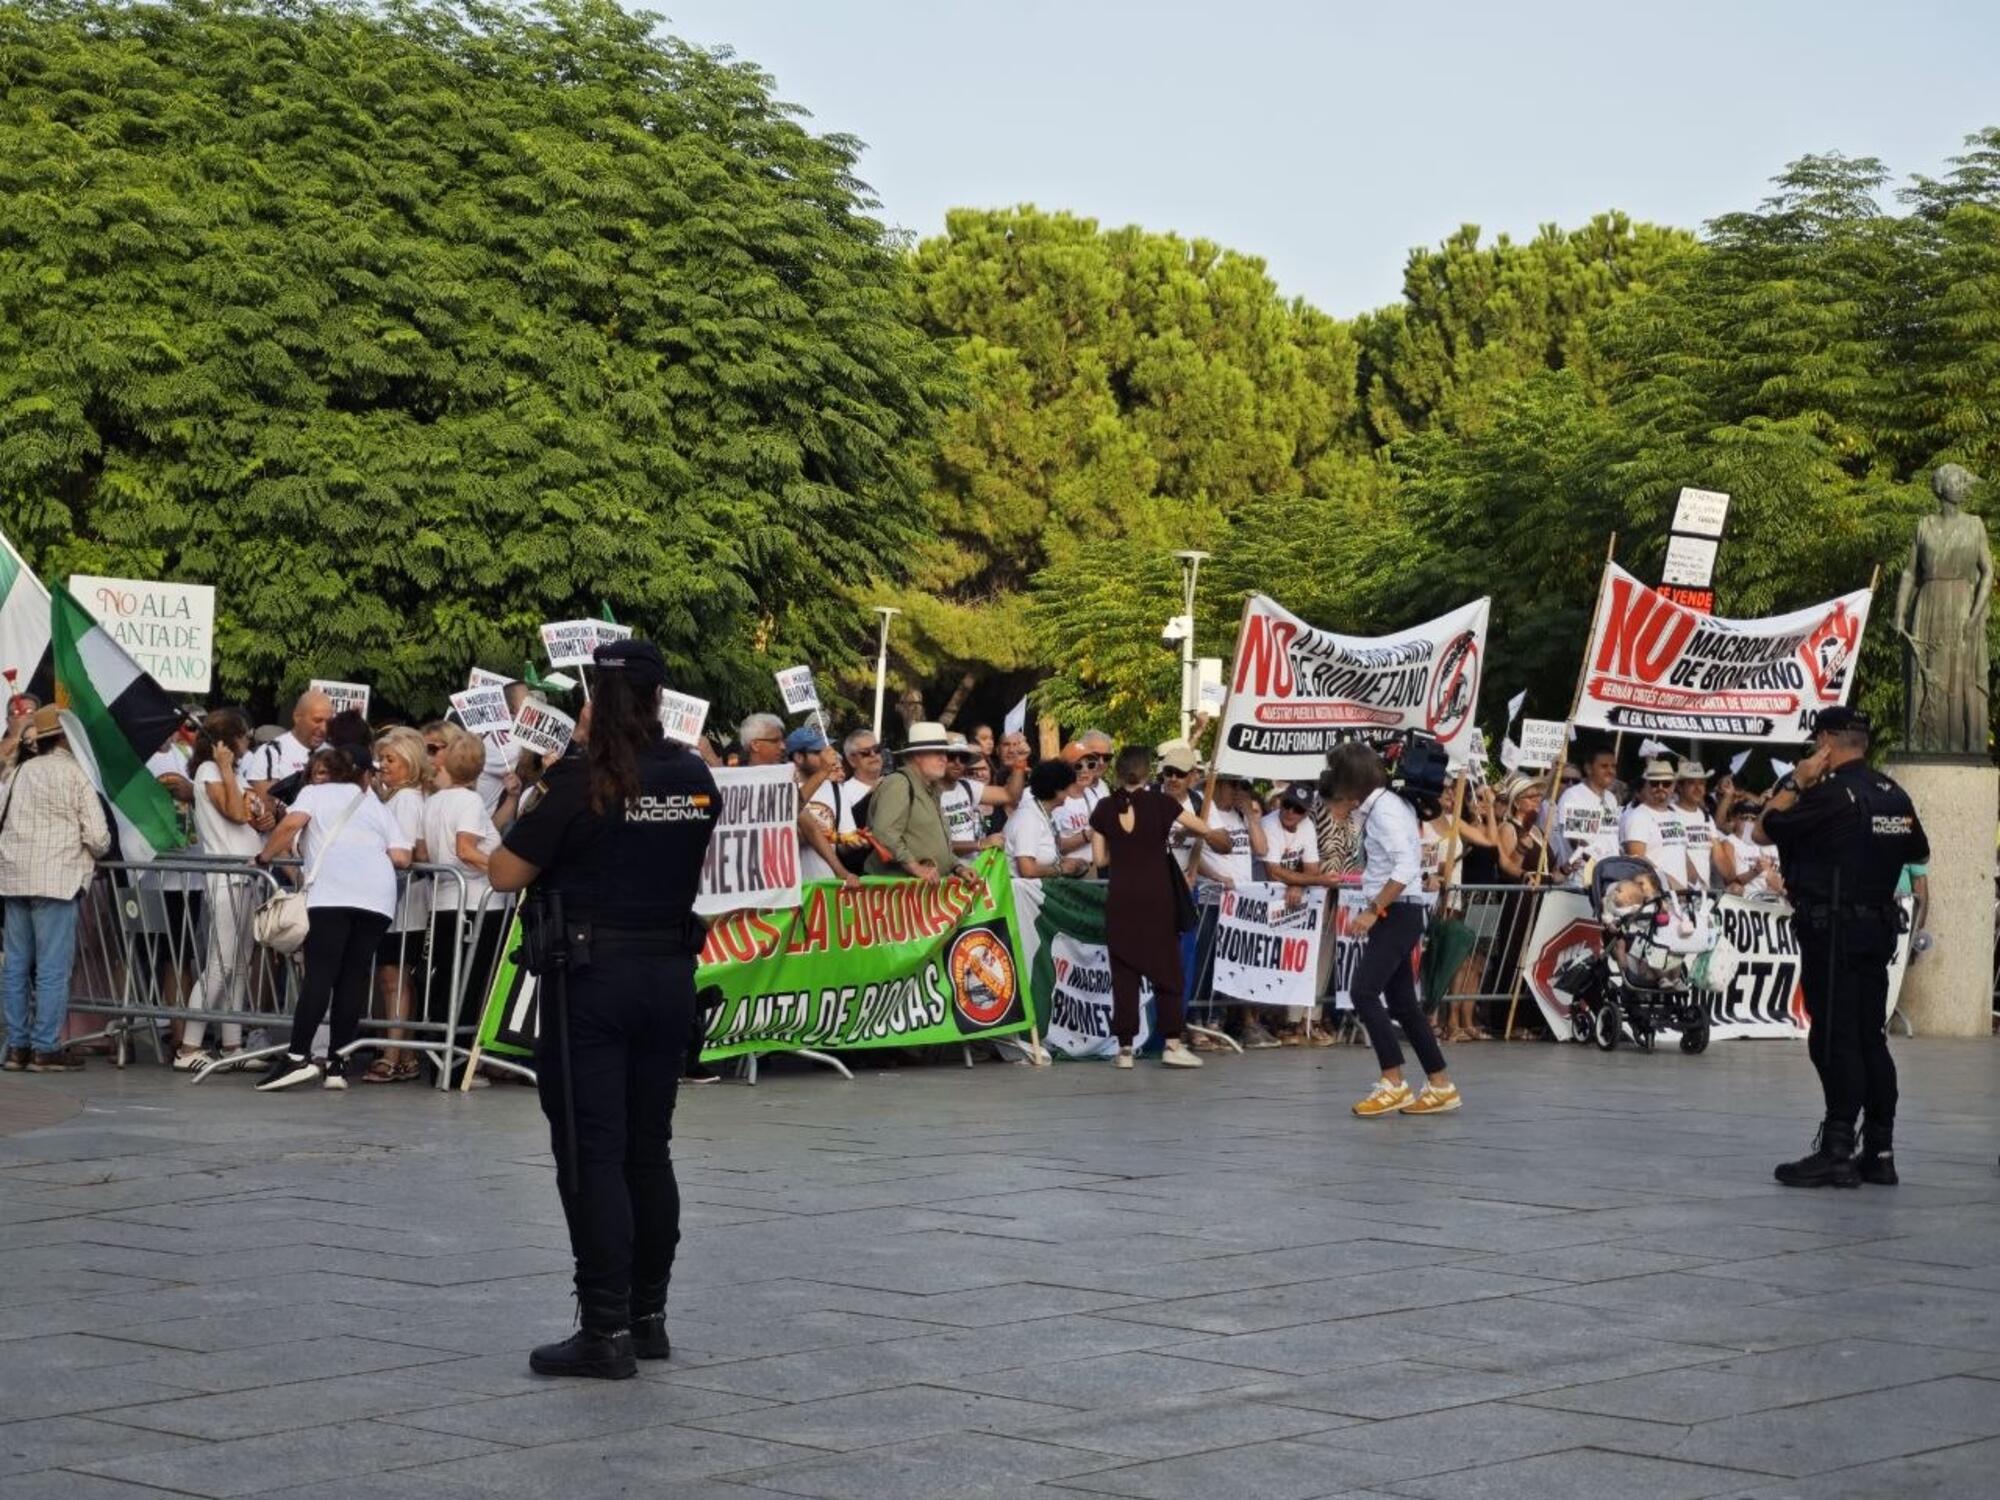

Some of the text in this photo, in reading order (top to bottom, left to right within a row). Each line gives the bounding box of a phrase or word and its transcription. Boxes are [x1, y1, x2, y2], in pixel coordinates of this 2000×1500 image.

[97, 588, 138, 617] NO
[1673, 589, 1713, 609] VENDE
[112, 621, 201, 650] ANTA DE
[1290, 629, 1313, 650] A
[1307, 635, 1335, 658] LA
[1595, 577, 1697, 684] NO
[1235, 614, 1297, 698] NO
[1290, 654, 1429, 707] DE BIOMETANO
[1669, 658, 1804, 690] DE BIOMETANO
[1238, 728, 1322, 752] PLATAFORMA
[1701, 717, 1715, 731] NI
[1714, 718, 1730, 733] EN
[1730, 719, 1745, 733] EL
[625, 808, 711, 823] NACIONAL
[718, 782, 794, 826] ROPLANTA
[698, 826, 796, 896] METANO
[786, 886, 829, 955] LA
[1216, 923, 1309, 973] BIOMETANO
[1067, 965, 1113, 994] MACRO
[802, 987, 857, 1045] DE
[846, 962, 946, 1042] BIOGAS
